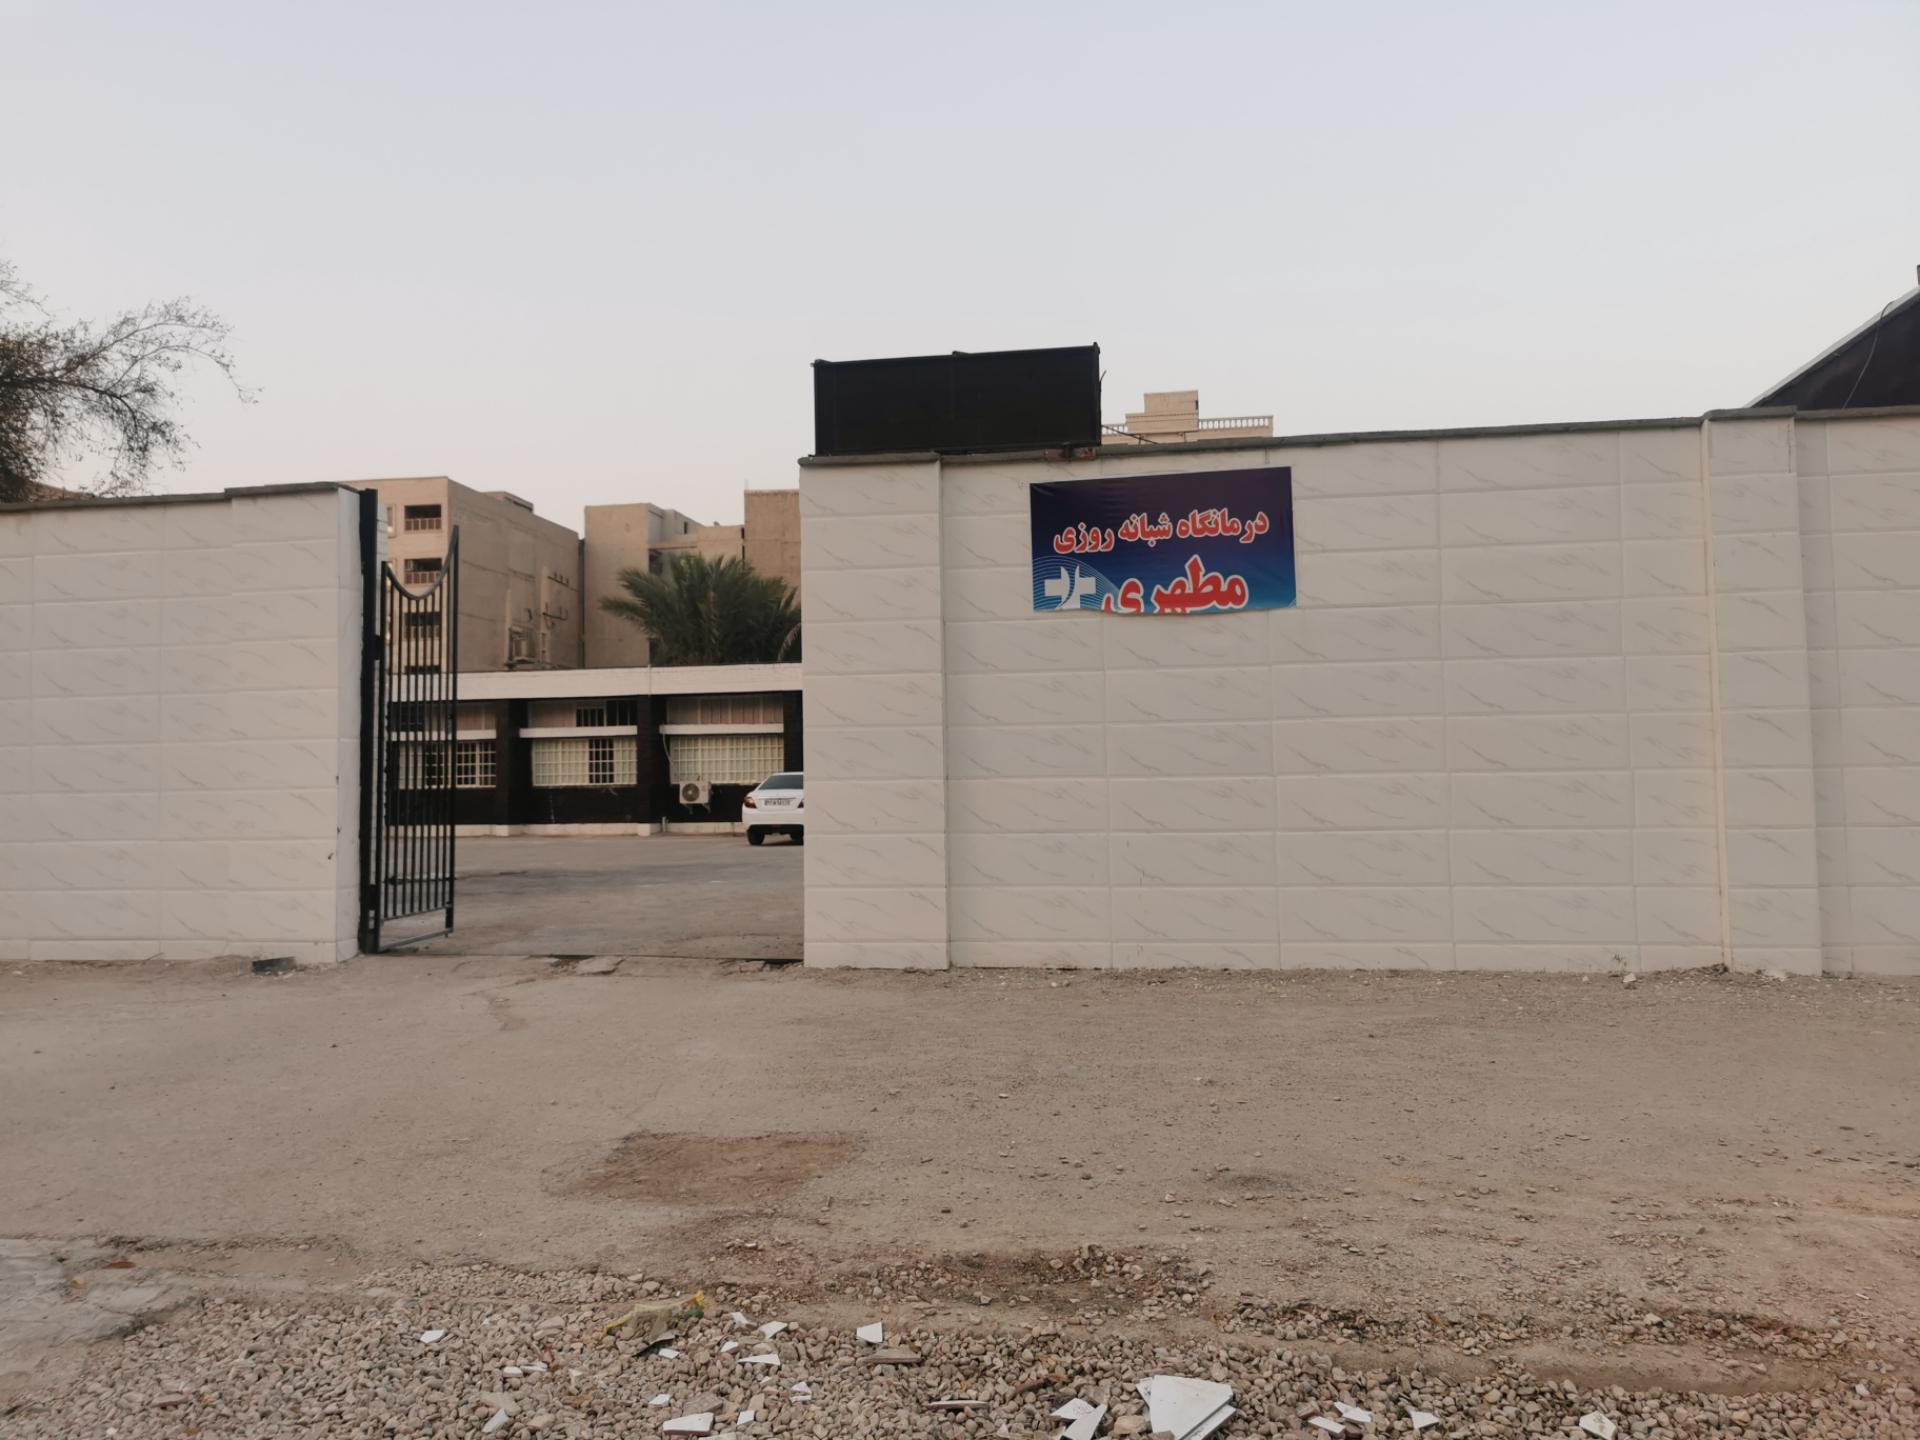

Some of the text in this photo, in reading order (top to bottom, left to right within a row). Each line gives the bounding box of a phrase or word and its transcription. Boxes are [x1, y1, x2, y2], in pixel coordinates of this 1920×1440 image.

[1053, 508, 1269, 554] درمانگاه شبانه روزی
